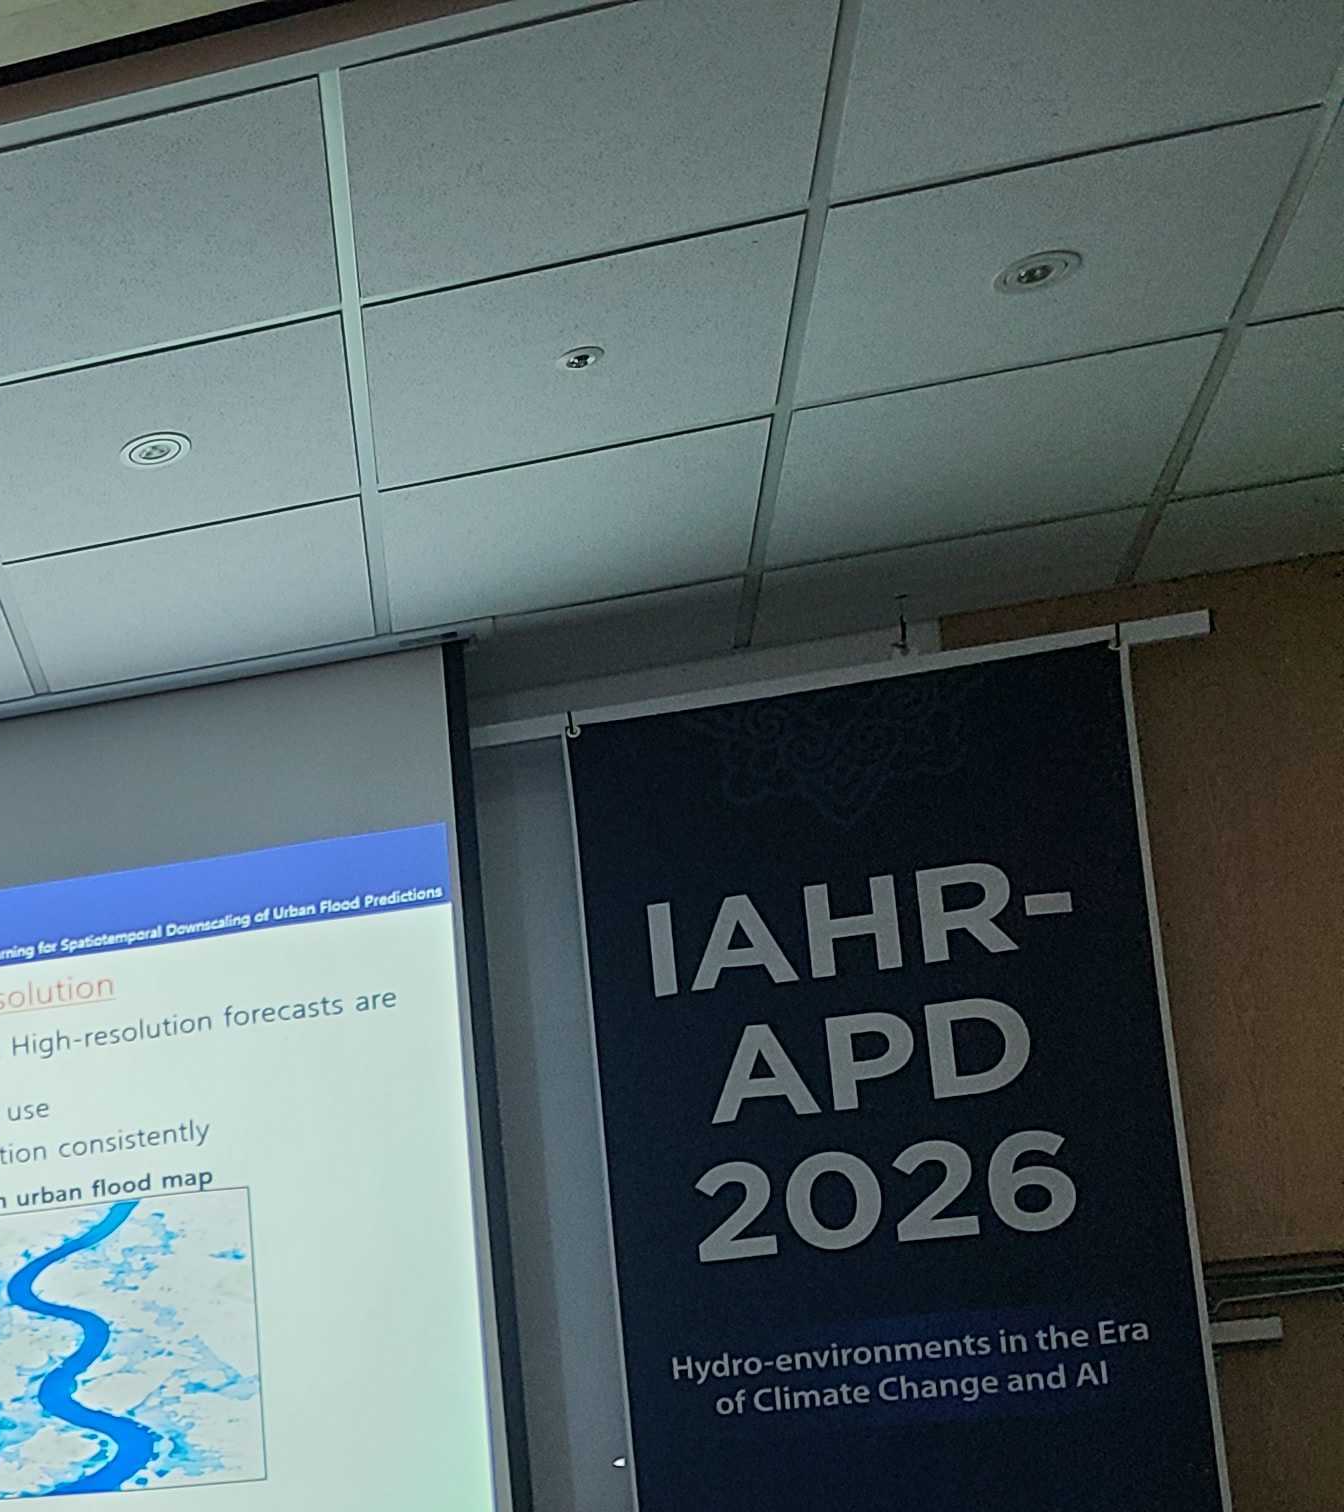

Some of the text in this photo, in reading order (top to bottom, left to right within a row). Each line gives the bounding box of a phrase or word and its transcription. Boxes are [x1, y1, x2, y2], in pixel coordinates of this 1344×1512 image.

[38, 940, 58, 955] for
[61, 925, 162, 955] Spatiotemporal
[166, 914, 250, 939] Downscaling
[255, 908, 269, 922] of
[273, 903, 316, 921] Urban
[320, 897, 360, 915] Flood
[365, 887, 443, 908] Predictions
[646, 862, 1073, 998] IAHR-
[11, 1014, 212, 1060] High-resolution
[223, 996, 344, 1028] forecasts
[355, 991, 397, 1012] are
[712, 998, 1031, 1124] APD
[58, 1119, 210, 1158] consistently
[17, 1184, 83, 1210] urban
[92, 1172, 151, 1199] flood
[161, 1170, 214, 1195] map
[694, 1129, 1077, 1263] 2026
[671, 1319, 1149, 1385] Hydro-environments in the Era
[716, 1360, 1108, 1415] of Climate Change and AI
